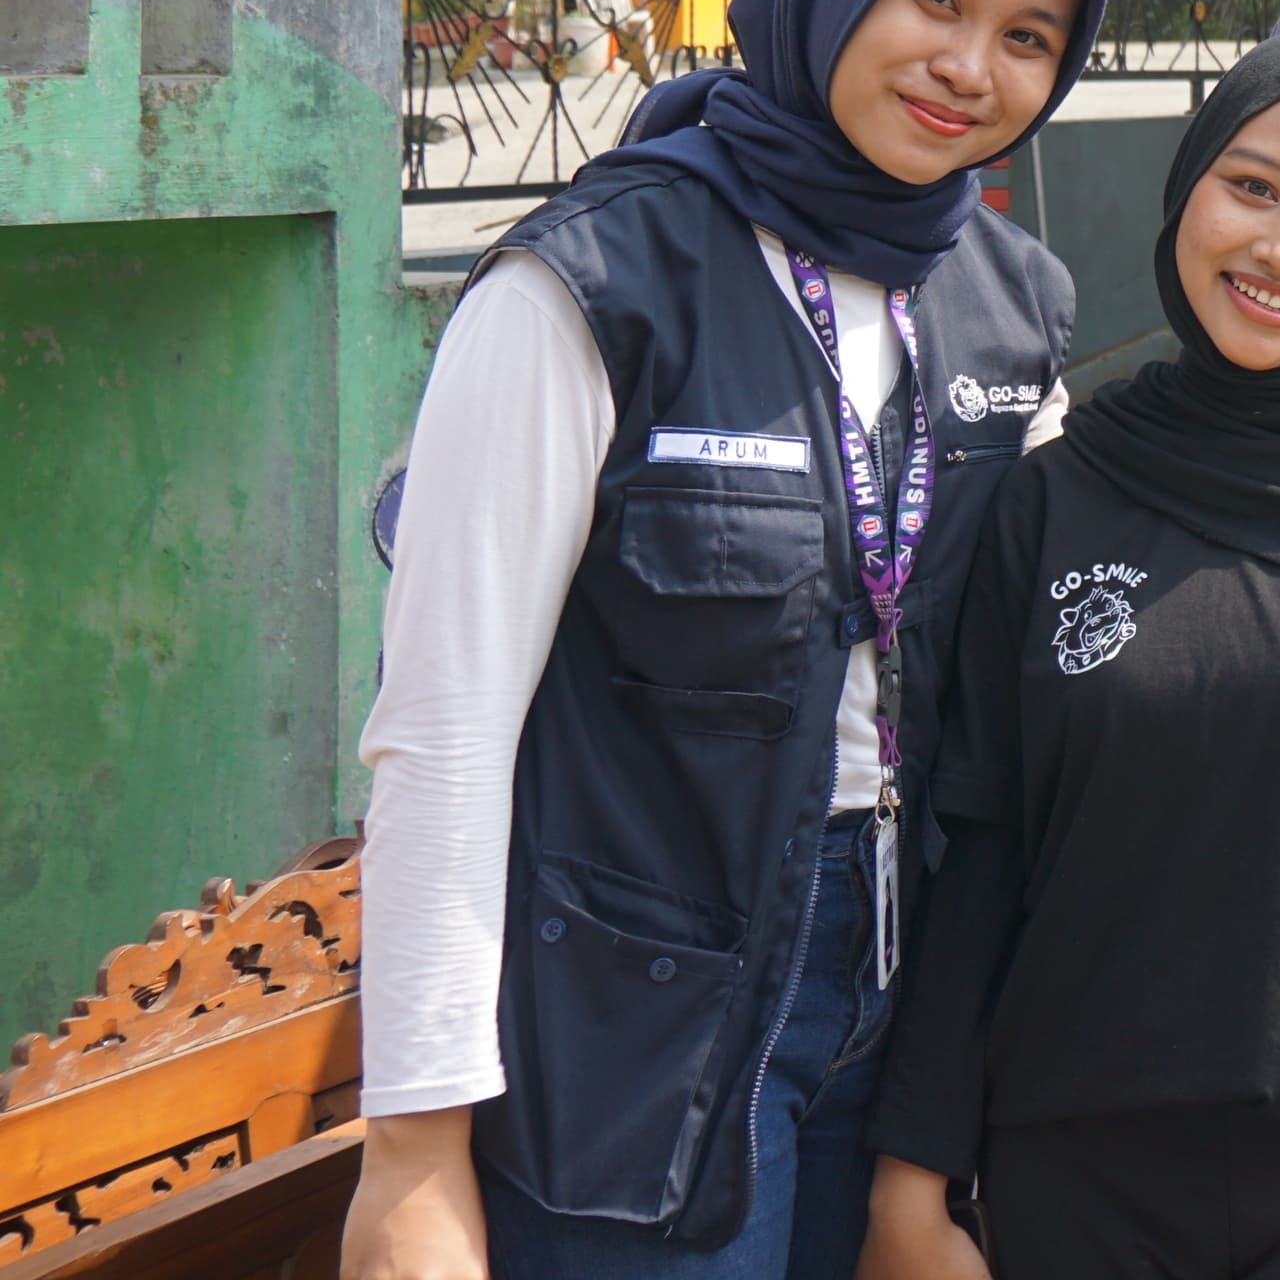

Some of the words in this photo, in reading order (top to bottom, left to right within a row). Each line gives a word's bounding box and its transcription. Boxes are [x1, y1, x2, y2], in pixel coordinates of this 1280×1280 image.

[699, 438, 768, 461] ARUM
[845, 431, 876, 506] HMTI
[906, 394, 929, 505] UDINUS
[1050, 562, 1149, 600] GO-SMILE
